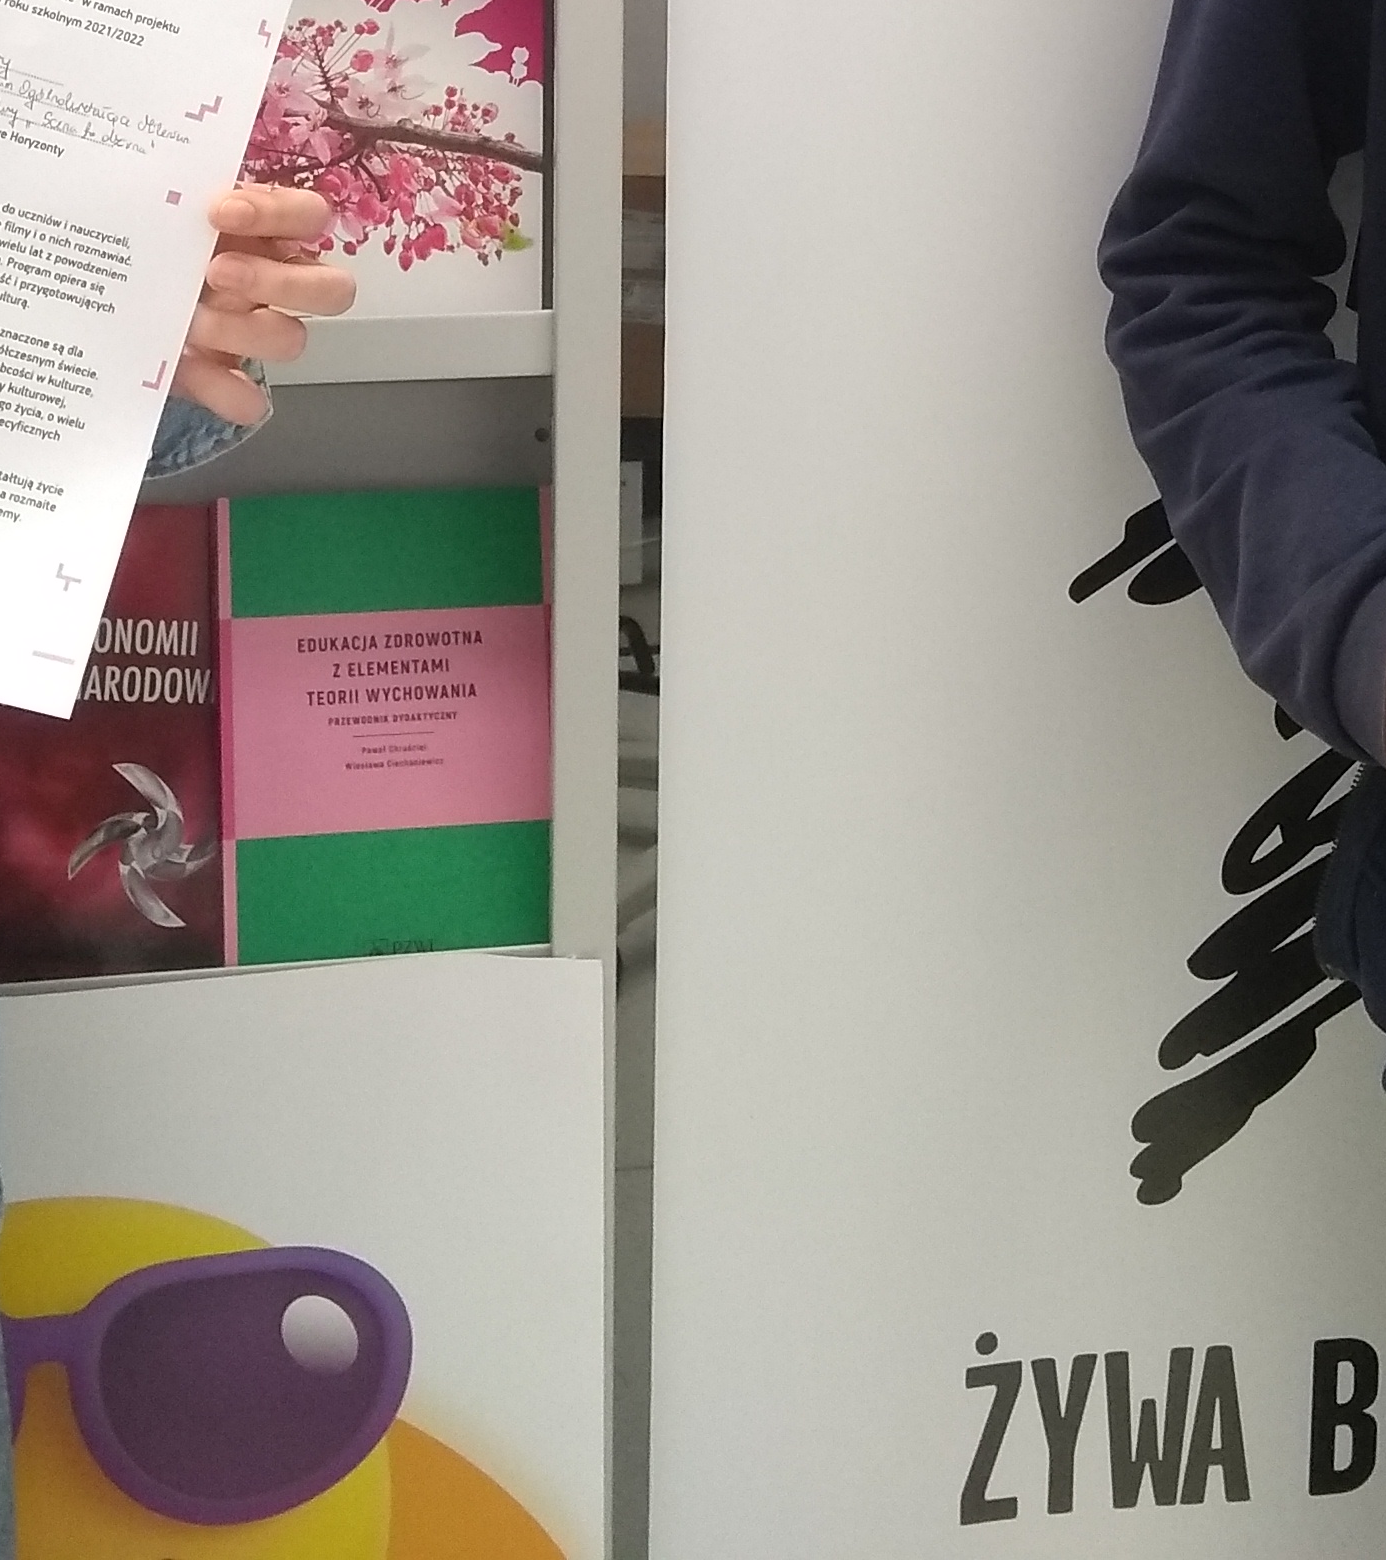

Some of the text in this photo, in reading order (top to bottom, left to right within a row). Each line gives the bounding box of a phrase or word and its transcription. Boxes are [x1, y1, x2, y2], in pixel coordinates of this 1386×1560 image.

[30, 5, 83, 29] szkolnym
[83, 19, 146, 48] 2021/2022
[92, 0, 134, 22] ramach
[133, 13, 181, 35] projektu
[93, 617, 199, 657] ONOMII
[297, 630, 483, 653] EDUKACJA ZDROWOTNA
[77, 665, 213, 705] ARODOW
[332, 658, 450, 678] Z ELEMENTAMI
[306, 683, 477, 706] TEORII WYCHOWANIA
[328, 711, 458, 726] PRZEWODNIK DYDAKTYCZNY
[960, 1331, 1251, 1526] ŻYWA
